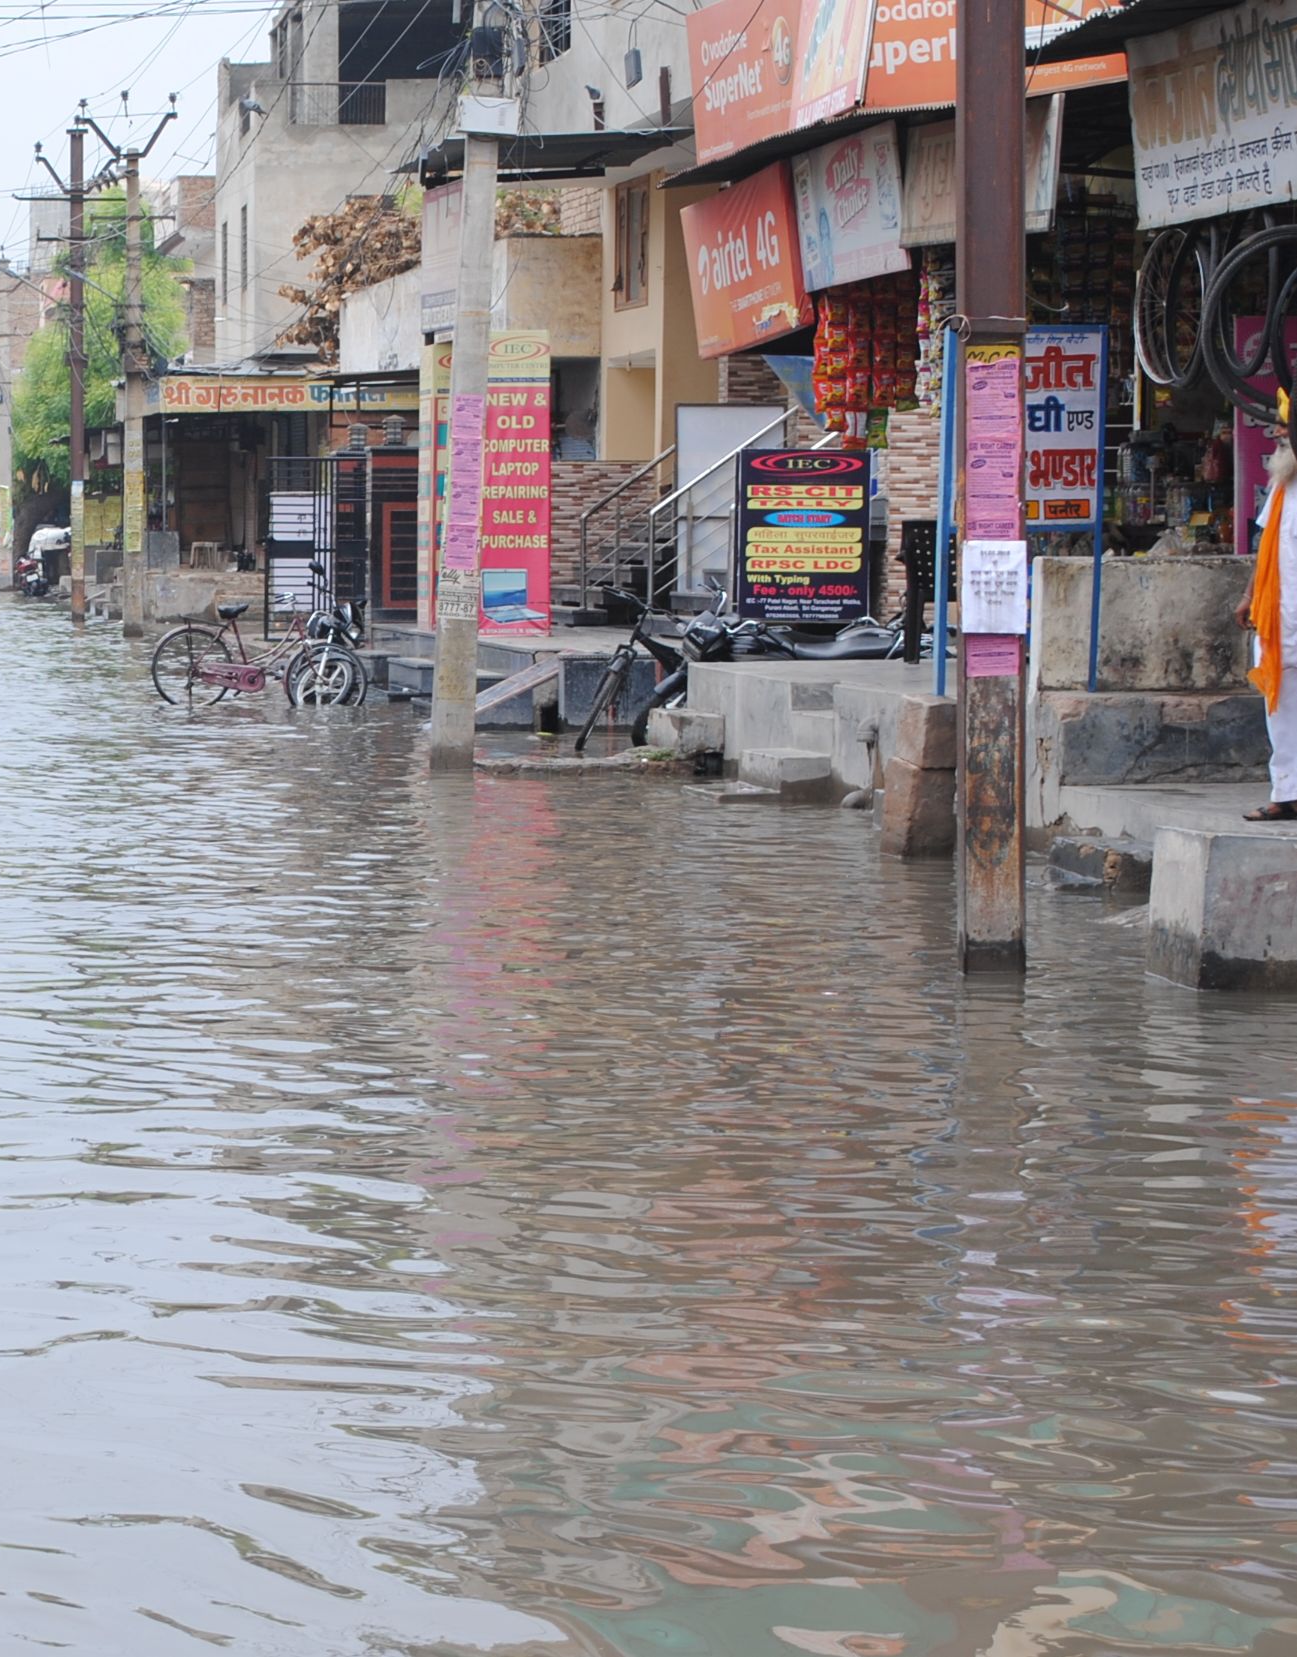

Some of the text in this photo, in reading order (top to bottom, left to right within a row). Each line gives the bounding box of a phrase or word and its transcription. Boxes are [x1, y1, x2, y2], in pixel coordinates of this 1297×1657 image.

[708, 29, 747, 60] vodafone
[774, 27, 791, 68] 4G
[869, 28, 956, 74] uper
[1074, 60, 1107, 72] network
[705, 60, 763, 115] SuperNet
[832, 143, 859, 192] Daily
[711, 224, 753, 291] airtel
[755, 210, 780, 270] 4G
[504, 343, 532, 354] IEC
[1025, 345, 1097, 390] जीत
[164, 381, 192, 407] श्री
[239, 384, 305, 407] नानक
[486, 392, 547, 407] NEW &
[1026, 395, 1065, 433] घी
[1067, 410, 1095, 432] एण्ड
[496, 415, 536, 429] OLD
[483, 439, 550, 453] COMPUTER
[491, 462, 540, 476] LAPTOP
[786, 458, 831, 470] IEC
[1029, 449, 1097, 489] भण्डार
[482, 485, 549, 499] REPAIRING
[751, 486, 860, 497] RS-CIT
[754, 499, 853, 507] TALLY
[1047, 501, 1082, 516] पनीर
[492, 510, 537, 524] SALE &
[481, 534, 549, 549] PURCHASE
[752, 544, 854, 554] Tax Assistant
[750, 560, 854, 570] RPSC LDC
[747, 574, 811, 585] With Typing
[753, 584, 777, 595] Fee
[787, 585, 815, 598] only
[818, 585, 859, 596] 4500/-
